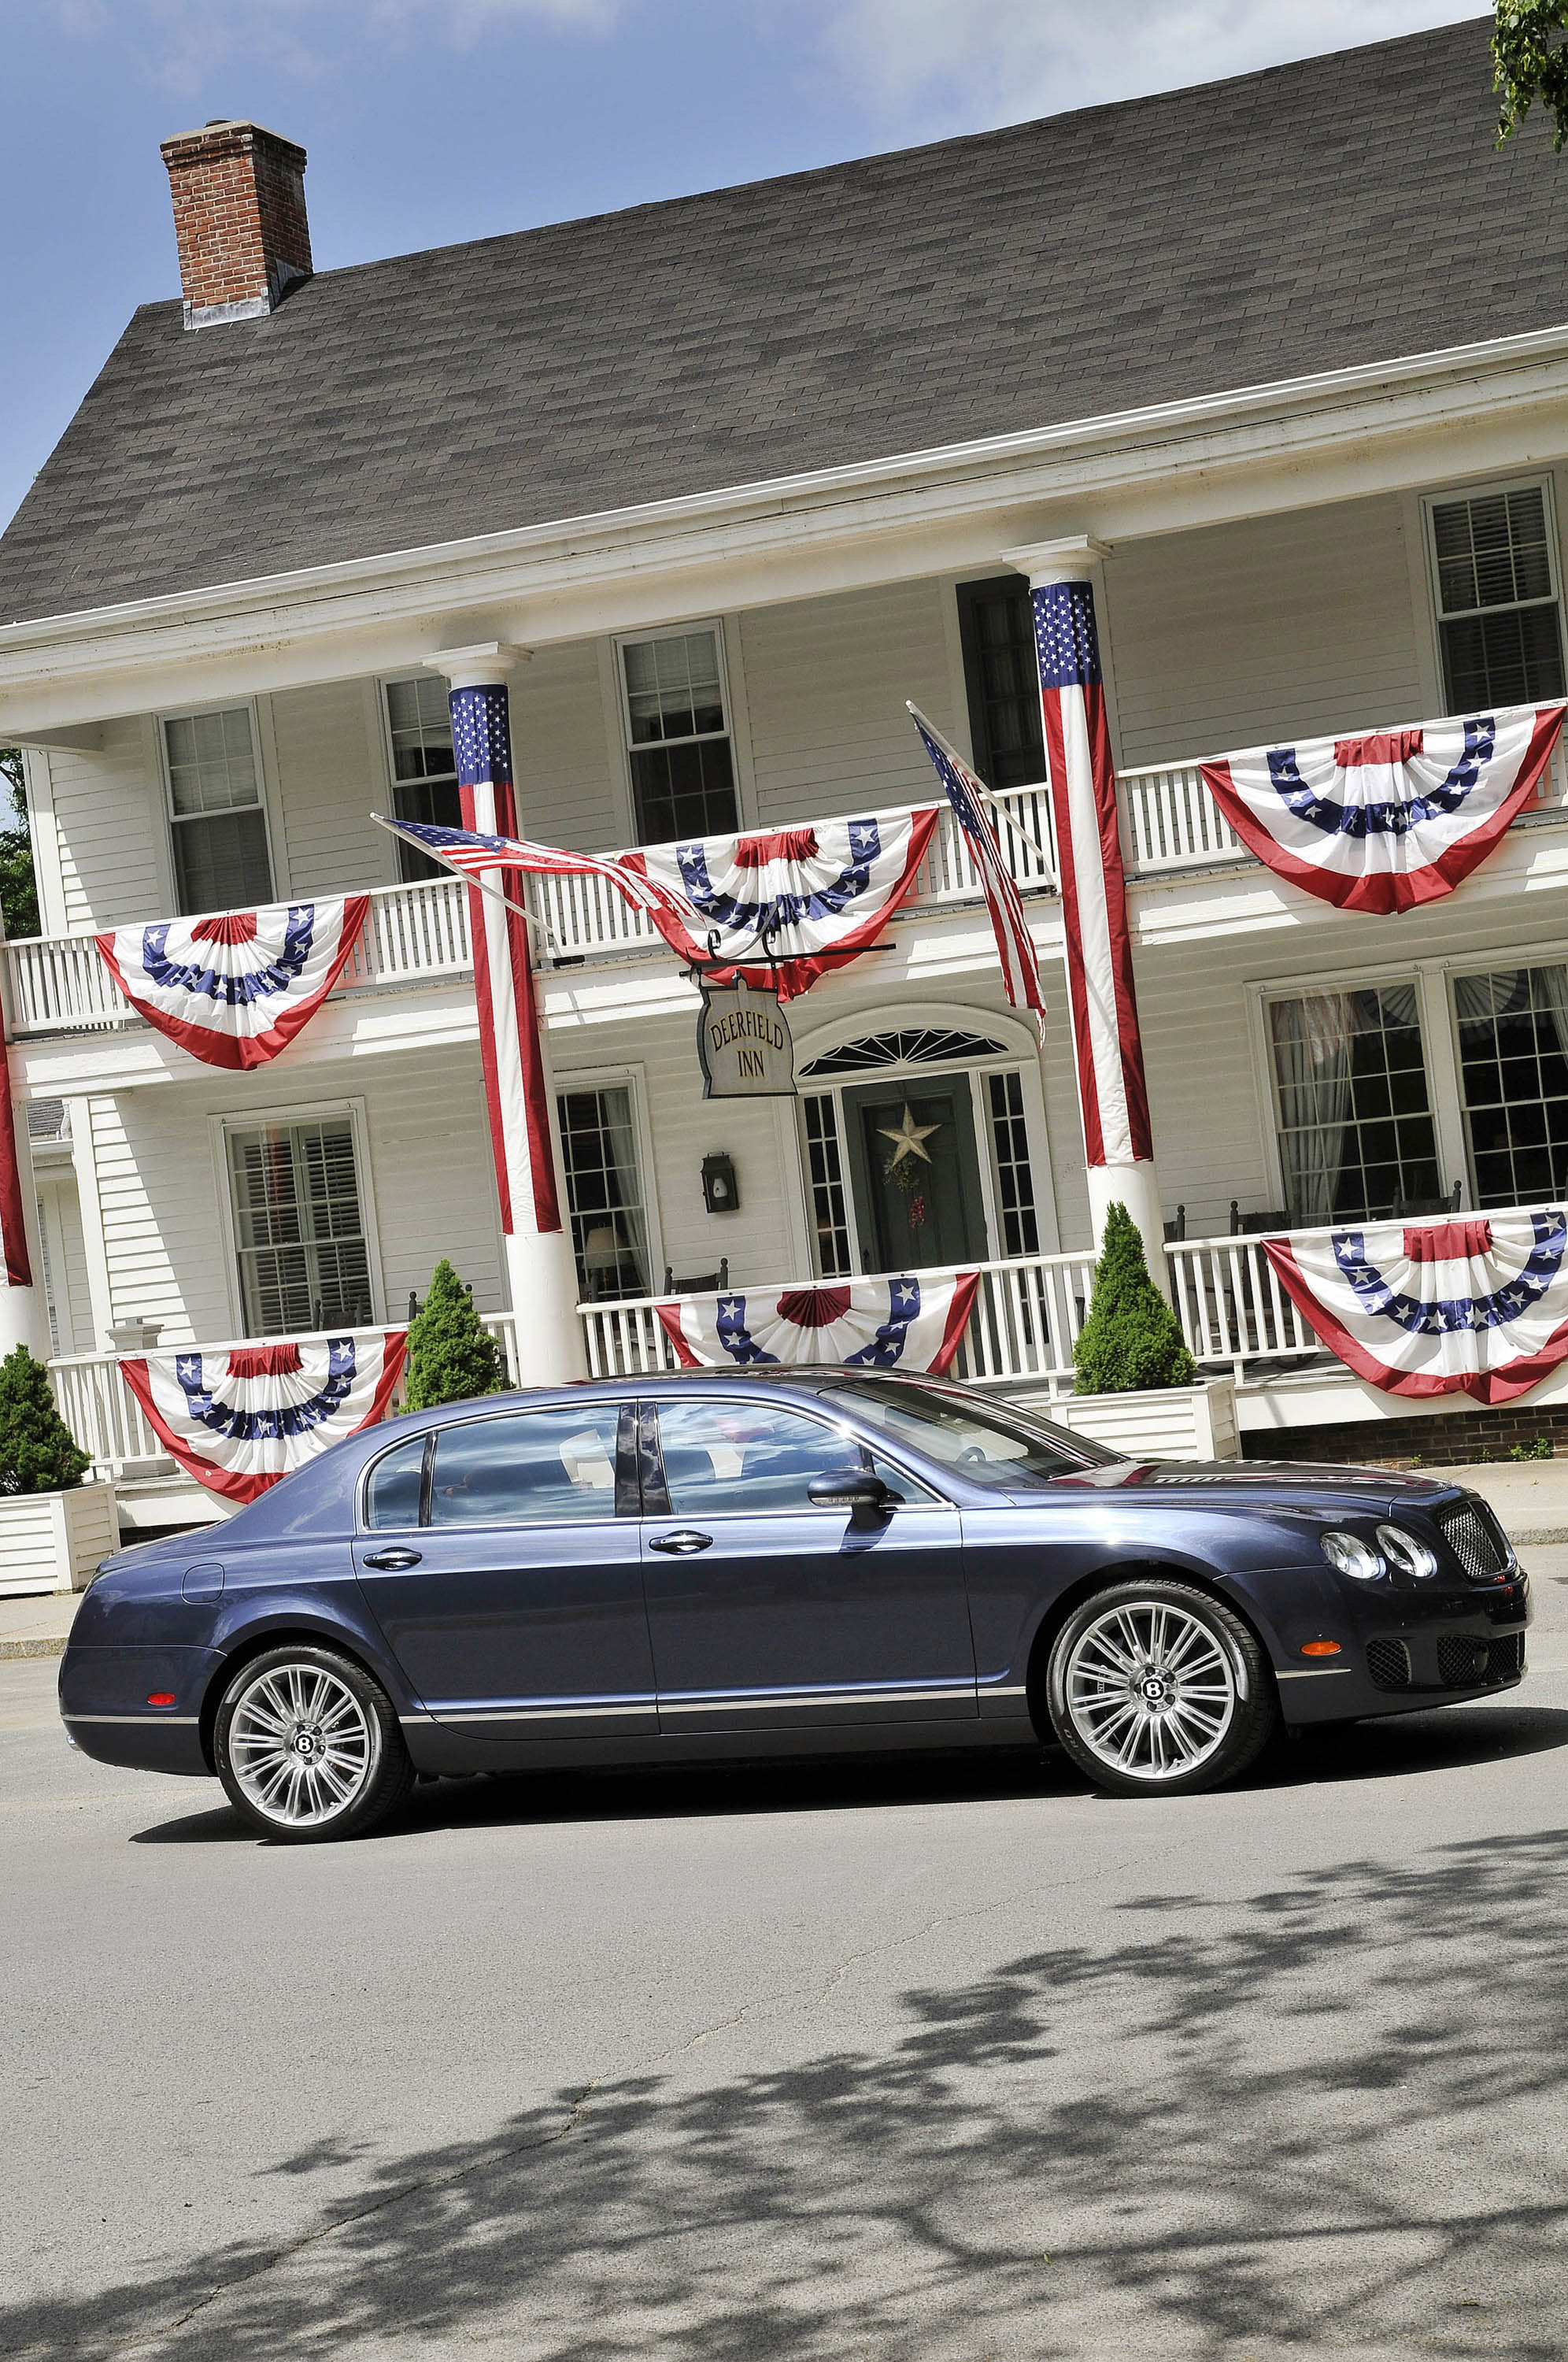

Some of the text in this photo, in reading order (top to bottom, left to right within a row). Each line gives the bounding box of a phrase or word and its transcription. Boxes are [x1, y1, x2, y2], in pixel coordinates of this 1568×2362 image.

[710, 1010, 784, 1053] DEERFIELD
[737, 1050, 765, 1078] INN
[1145, 1681, 1161, 1697] B
[298, 1737, 311, 1752] B
